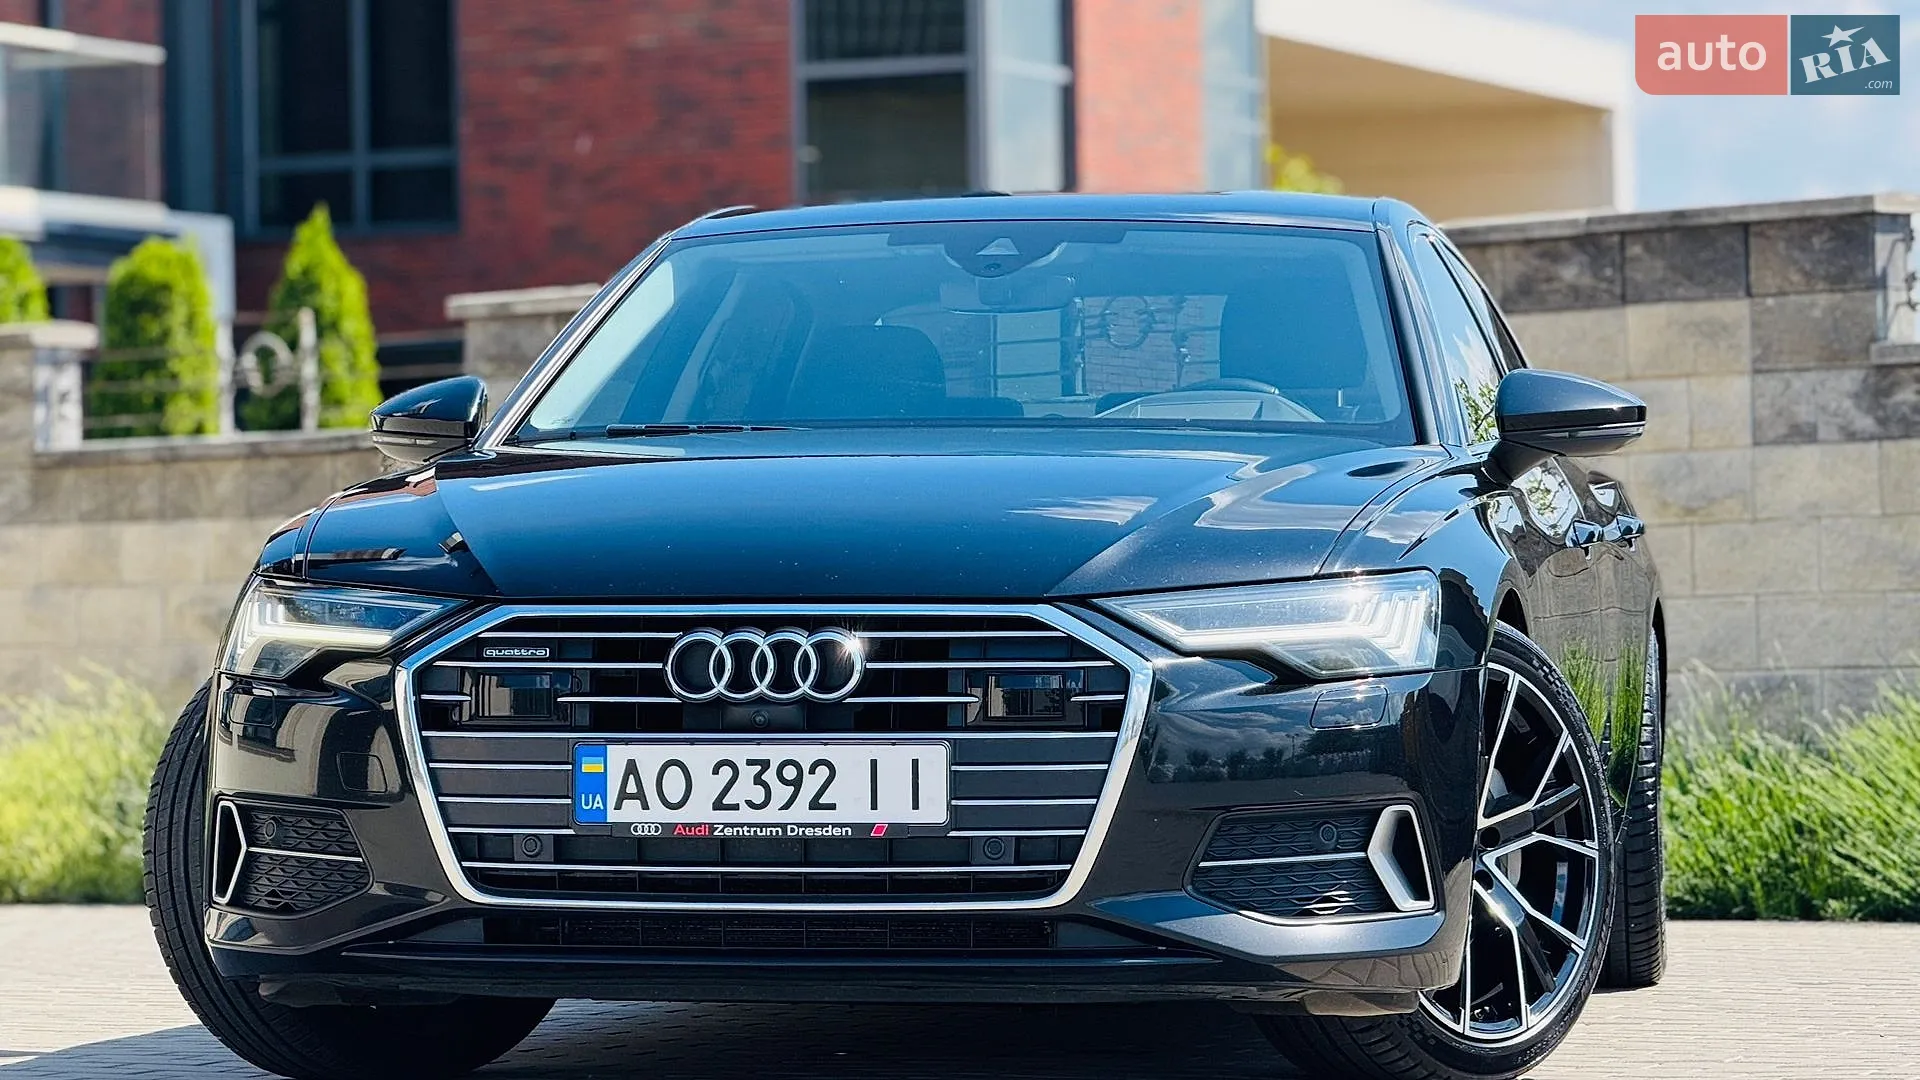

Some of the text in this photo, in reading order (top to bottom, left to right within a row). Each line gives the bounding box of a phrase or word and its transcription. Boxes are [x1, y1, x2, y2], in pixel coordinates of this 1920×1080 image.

[485, 648, 546, 657] quattro
[613, 758, 693, 811] AO
[711, 758, 837, 811] 2392
[581, 793, 604, 810] UA
[673, 823, 852, 837] Audi Zentrum Dresden
